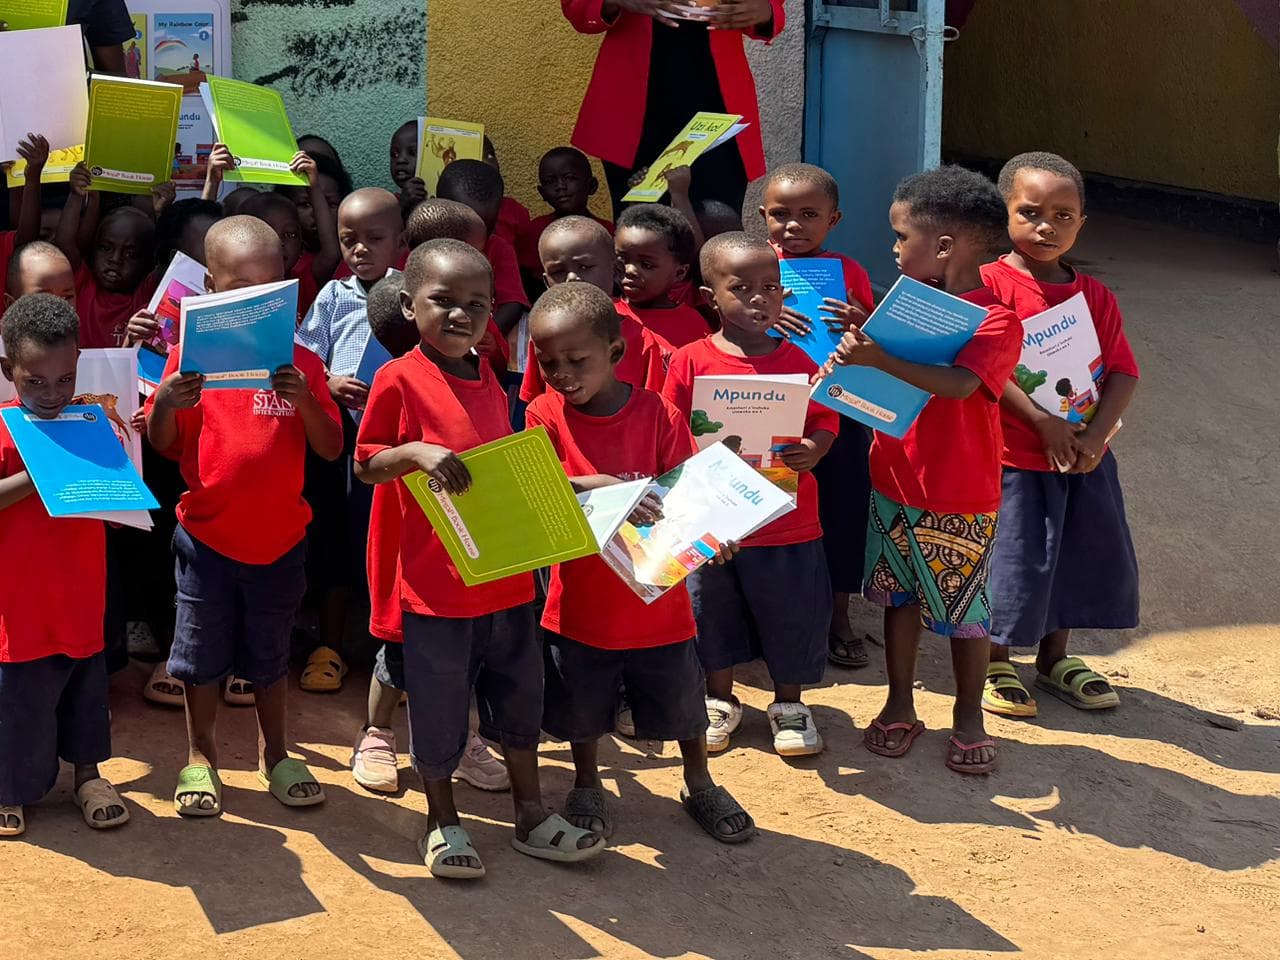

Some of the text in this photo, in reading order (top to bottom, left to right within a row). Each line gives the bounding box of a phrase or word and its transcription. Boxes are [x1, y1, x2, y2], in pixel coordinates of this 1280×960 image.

[1022, 313, 1078, 350] Mpundu
[253, 393, 296, 410] STAN
[713, 388, 786, 404] Mpundu
[707, 459, 765, 507] Mundu
